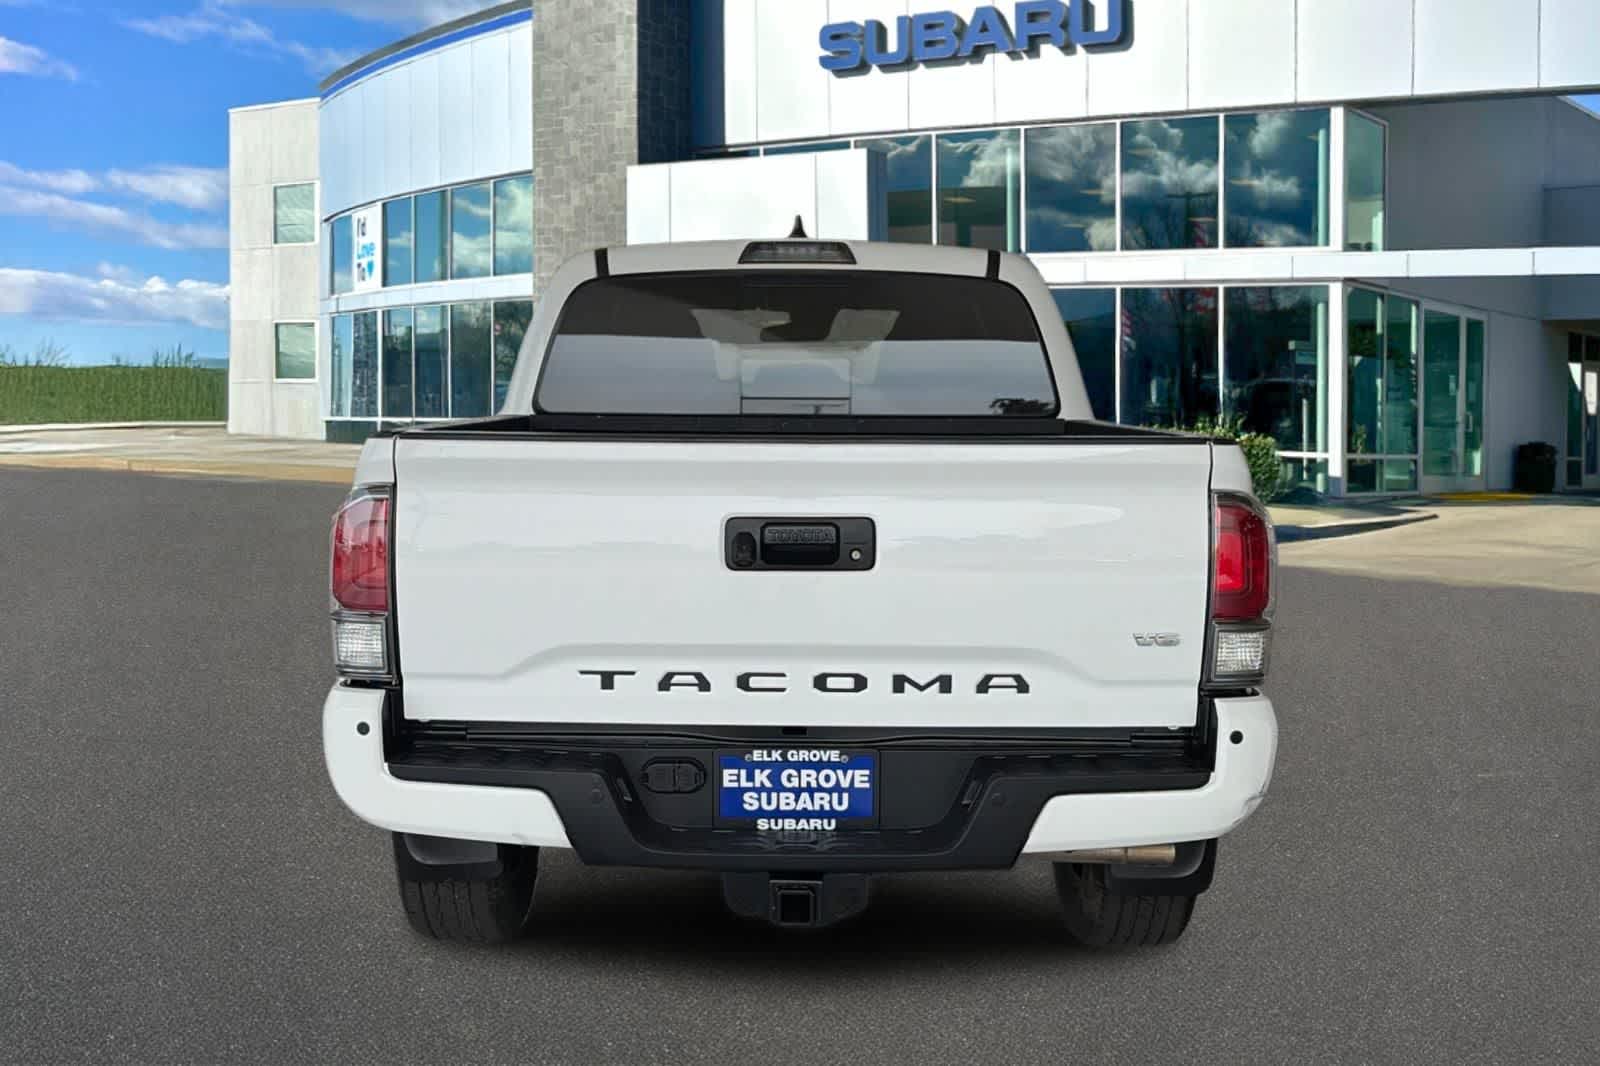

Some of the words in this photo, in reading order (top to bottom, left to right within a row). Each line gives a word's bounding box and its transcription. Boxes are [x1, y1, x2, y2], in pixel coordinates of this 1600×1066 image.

[819, 0, 1131, 74] SUBARU
[1132, 631, 1181, 648] V6
[578, 670, 1030, 694] TACOMA
[752, 750, 783, 762] ELK
[787, 750, 840, 762] GROVE
[722, 768, 773, 788] ELK
[780, 768, 870, 788] GROVE
[742, 791, 849, 811] SUBARU
[756, 818, 837, 831] SUBARU
